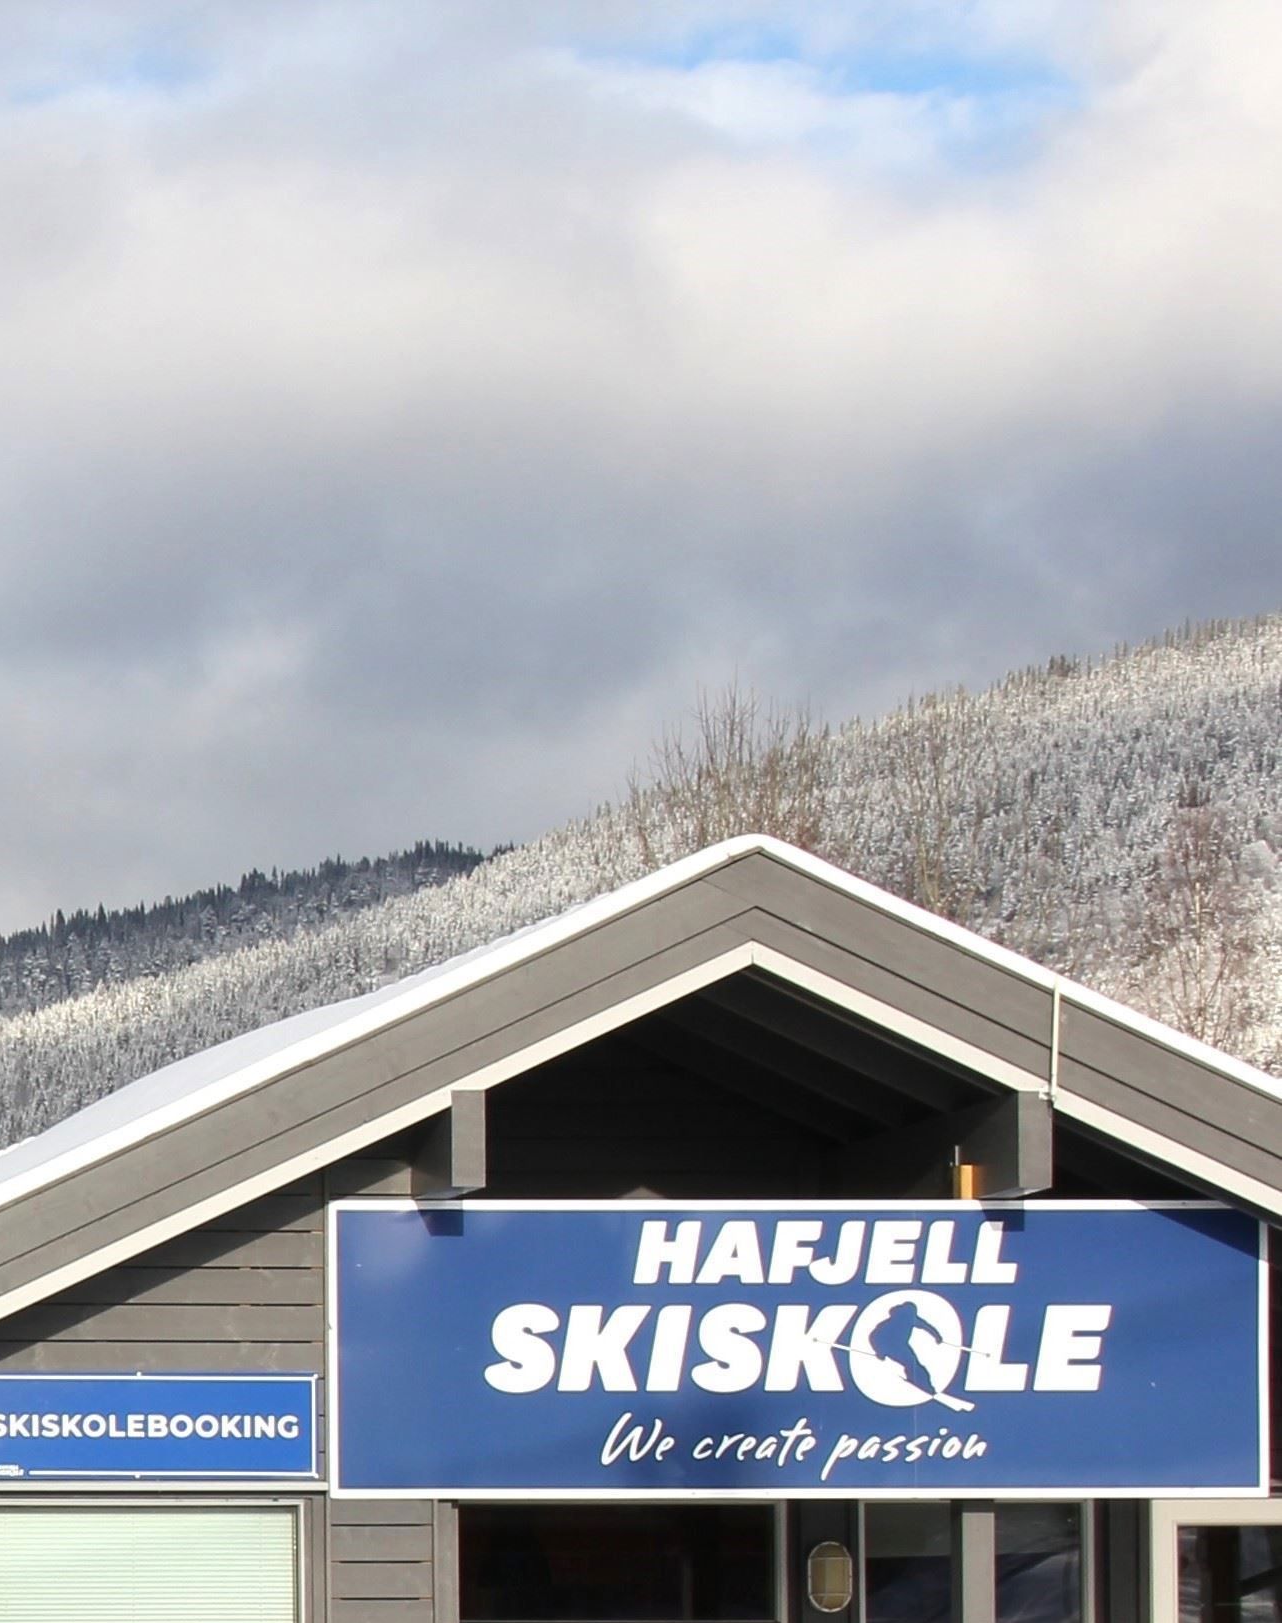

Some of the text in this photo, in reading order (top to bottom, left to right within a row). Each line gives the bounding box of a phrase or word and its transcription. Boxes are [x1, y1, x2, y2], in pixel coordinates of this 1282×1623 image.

[633, 1219, 1019, 1285] HAFJELL
[483, 1290, 1112, 1411] SKISKOLE
[600, 1411, 989, 1481] We create passion
